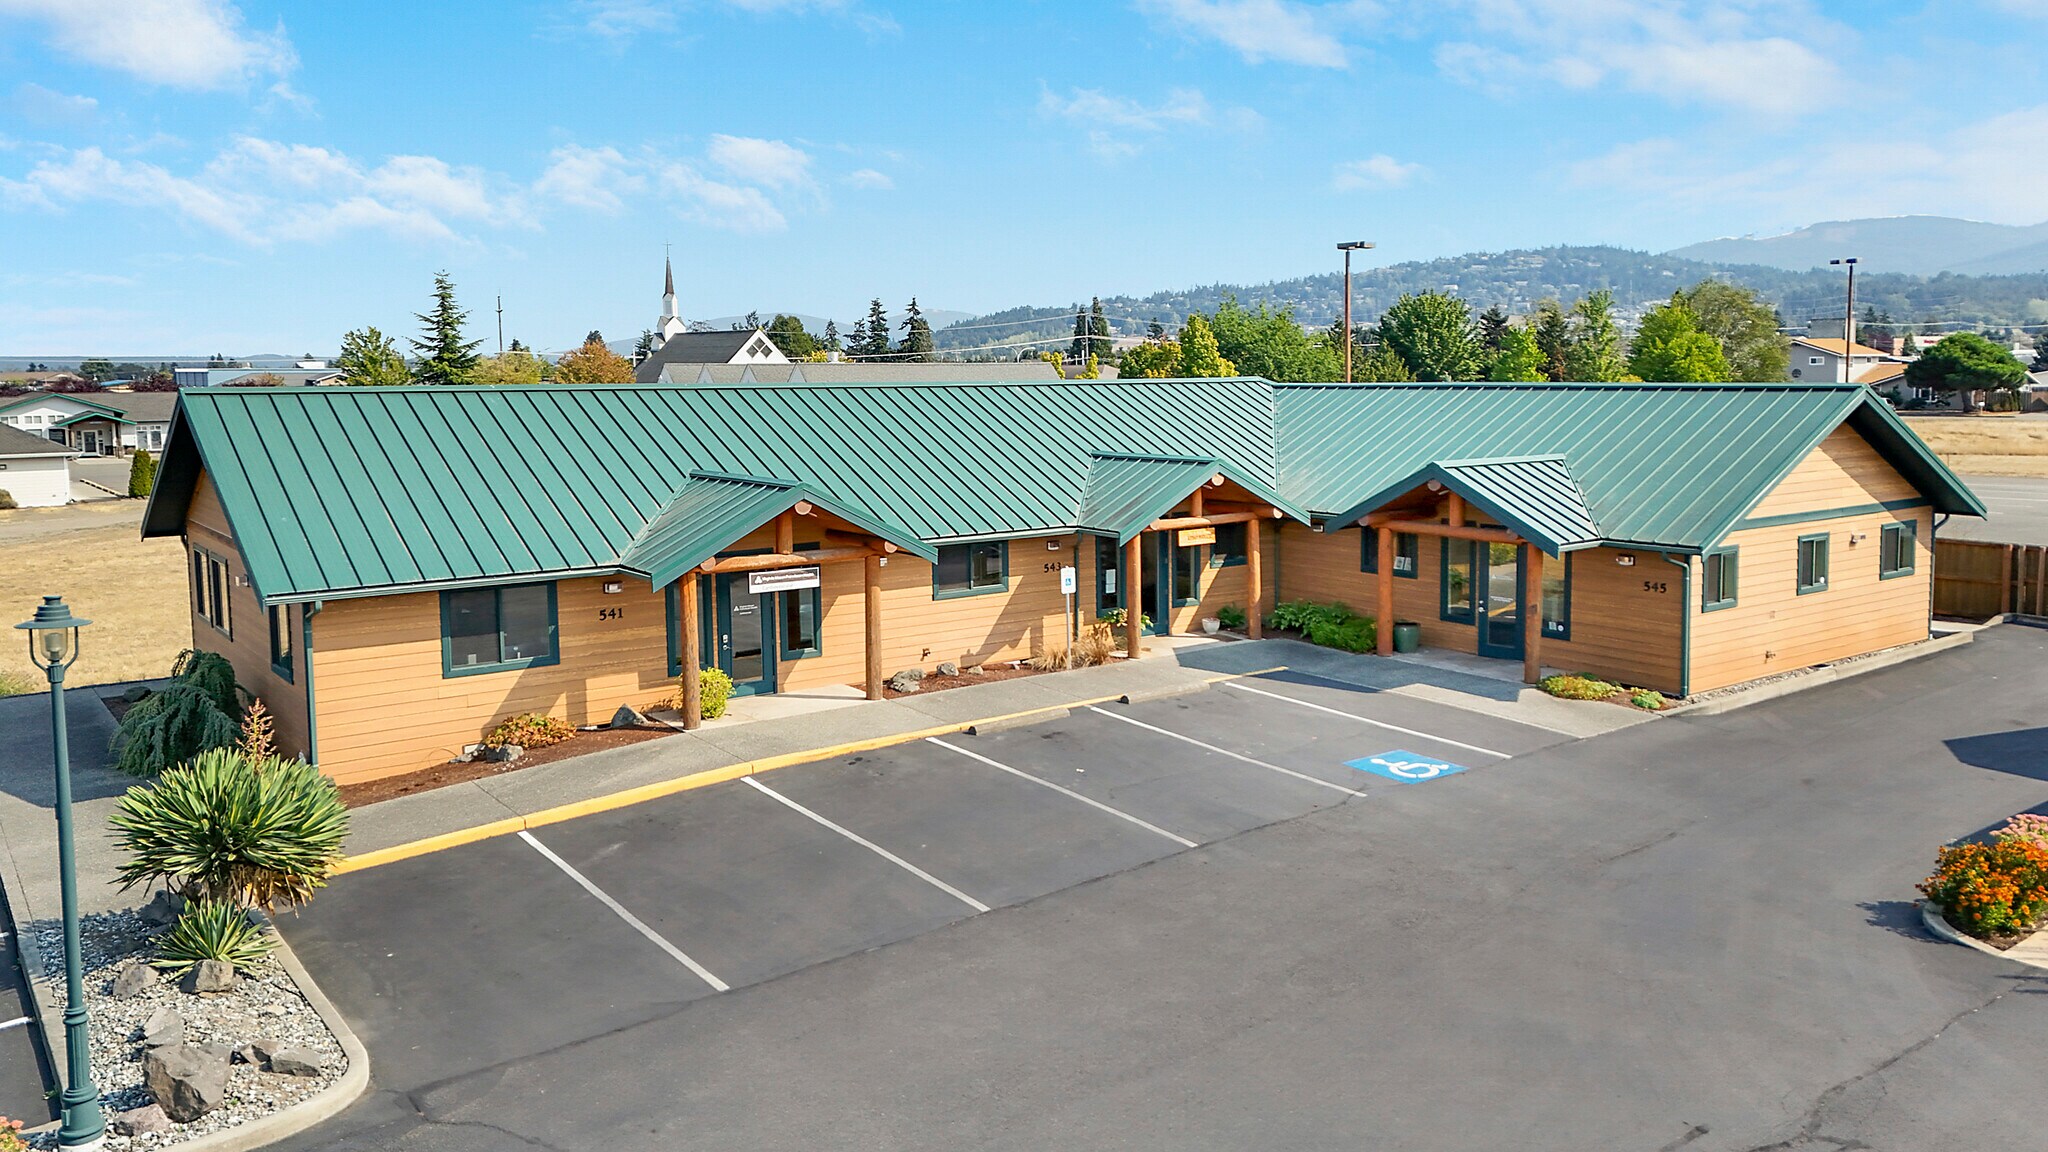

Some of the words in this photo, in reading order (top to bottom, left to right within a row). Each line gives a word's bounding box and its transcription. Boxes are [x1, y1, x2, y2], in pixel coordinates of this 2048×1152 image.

[1044, 562, 1062, 573] 543
[1644, 581, 1667, 594] 545
[599, 607, 624, 621] 541
